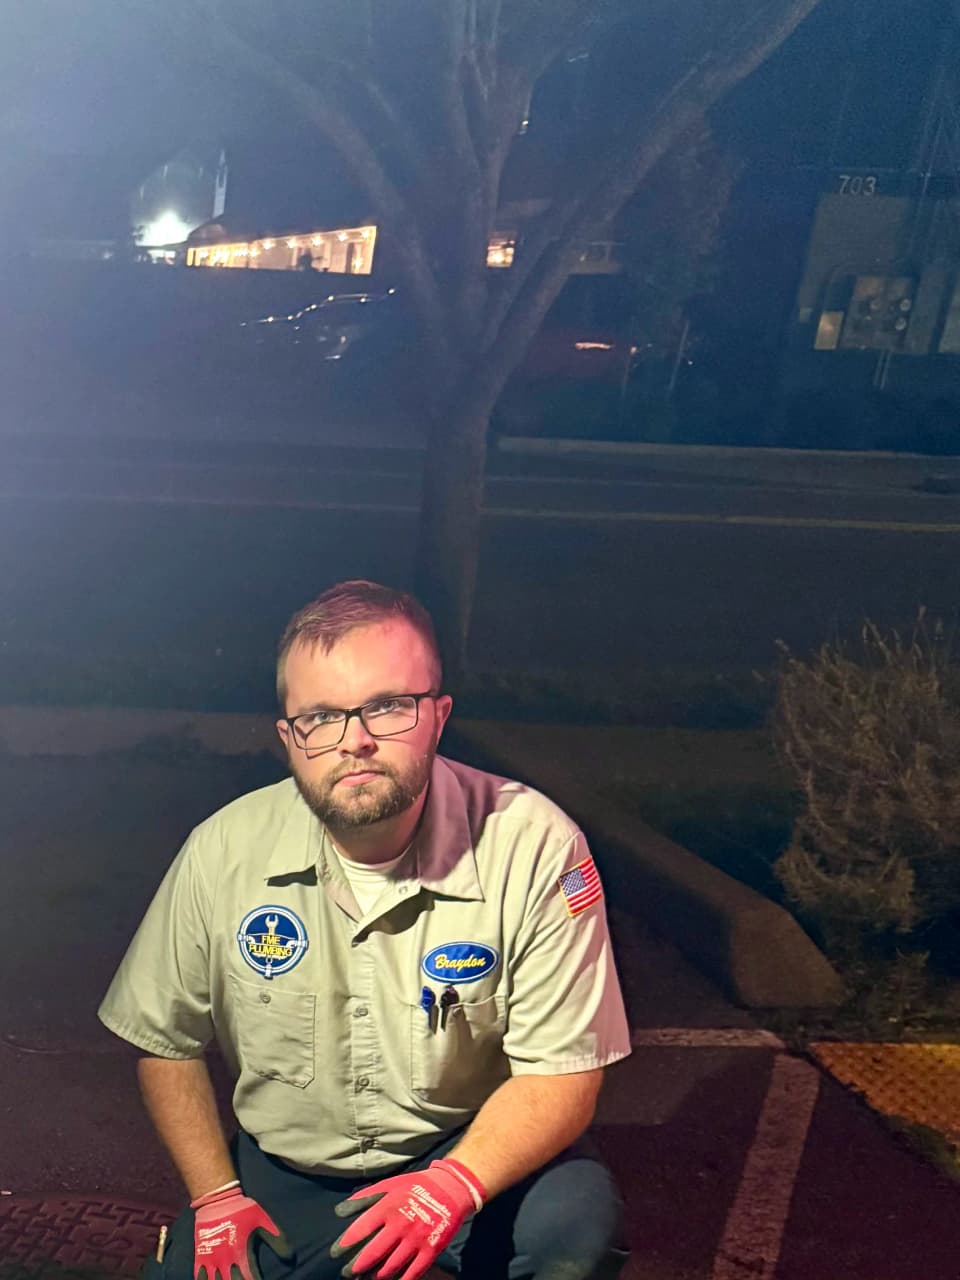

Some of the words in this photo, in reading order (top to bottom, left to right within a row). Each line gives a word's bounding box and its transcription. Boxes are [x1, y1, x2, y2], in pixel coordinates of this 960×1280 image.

[839, 175, 876, 196] 703
[248, 944, 293, 957] PLUMBING
[434, 953, 487, 973] Braydon
